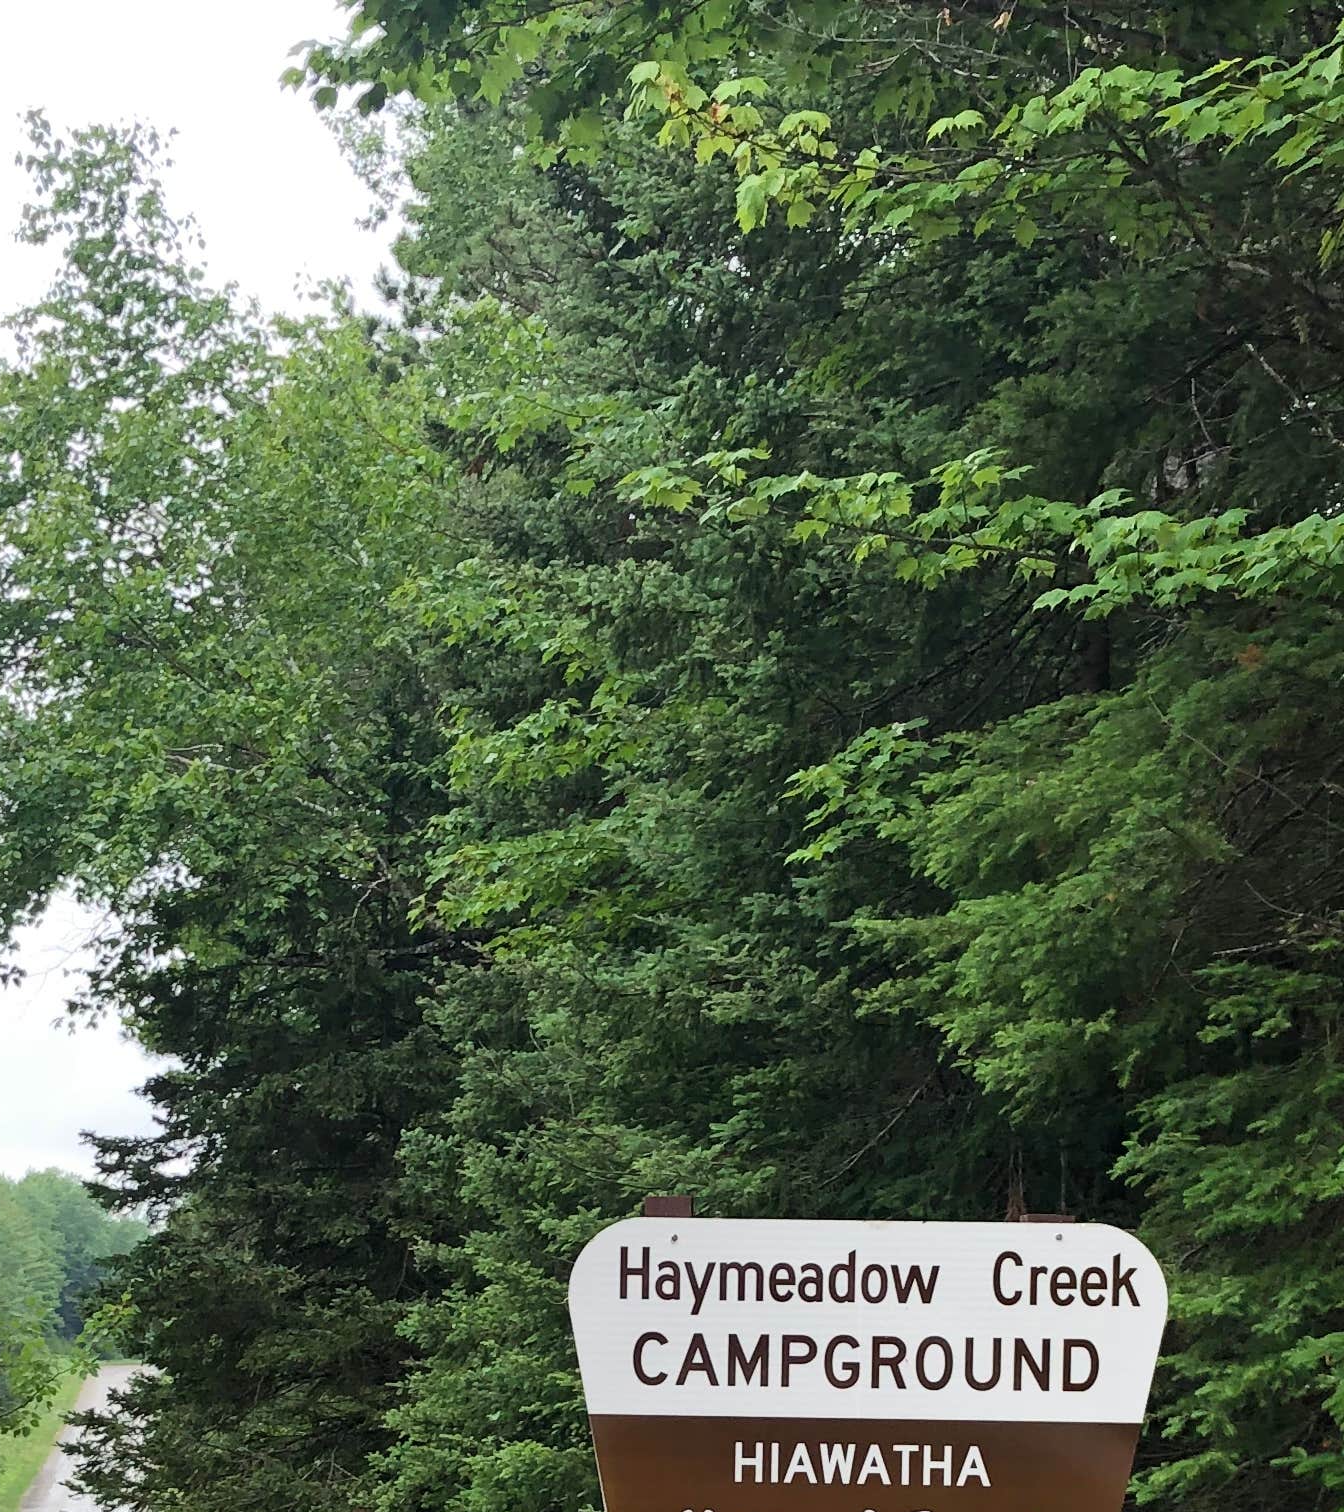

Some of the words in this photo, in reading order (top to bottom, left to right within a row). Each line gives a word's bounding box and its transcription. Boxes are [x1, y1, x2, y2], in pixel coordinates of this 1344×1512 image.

[619, 1245, 941, 1316] Haymeadow
[992, 1250, 1141, 1307] Creek
[632, 1331, 1100, 1392] CAMPGROUND
[734, 1441, 991, 1487] HIAWATHA
